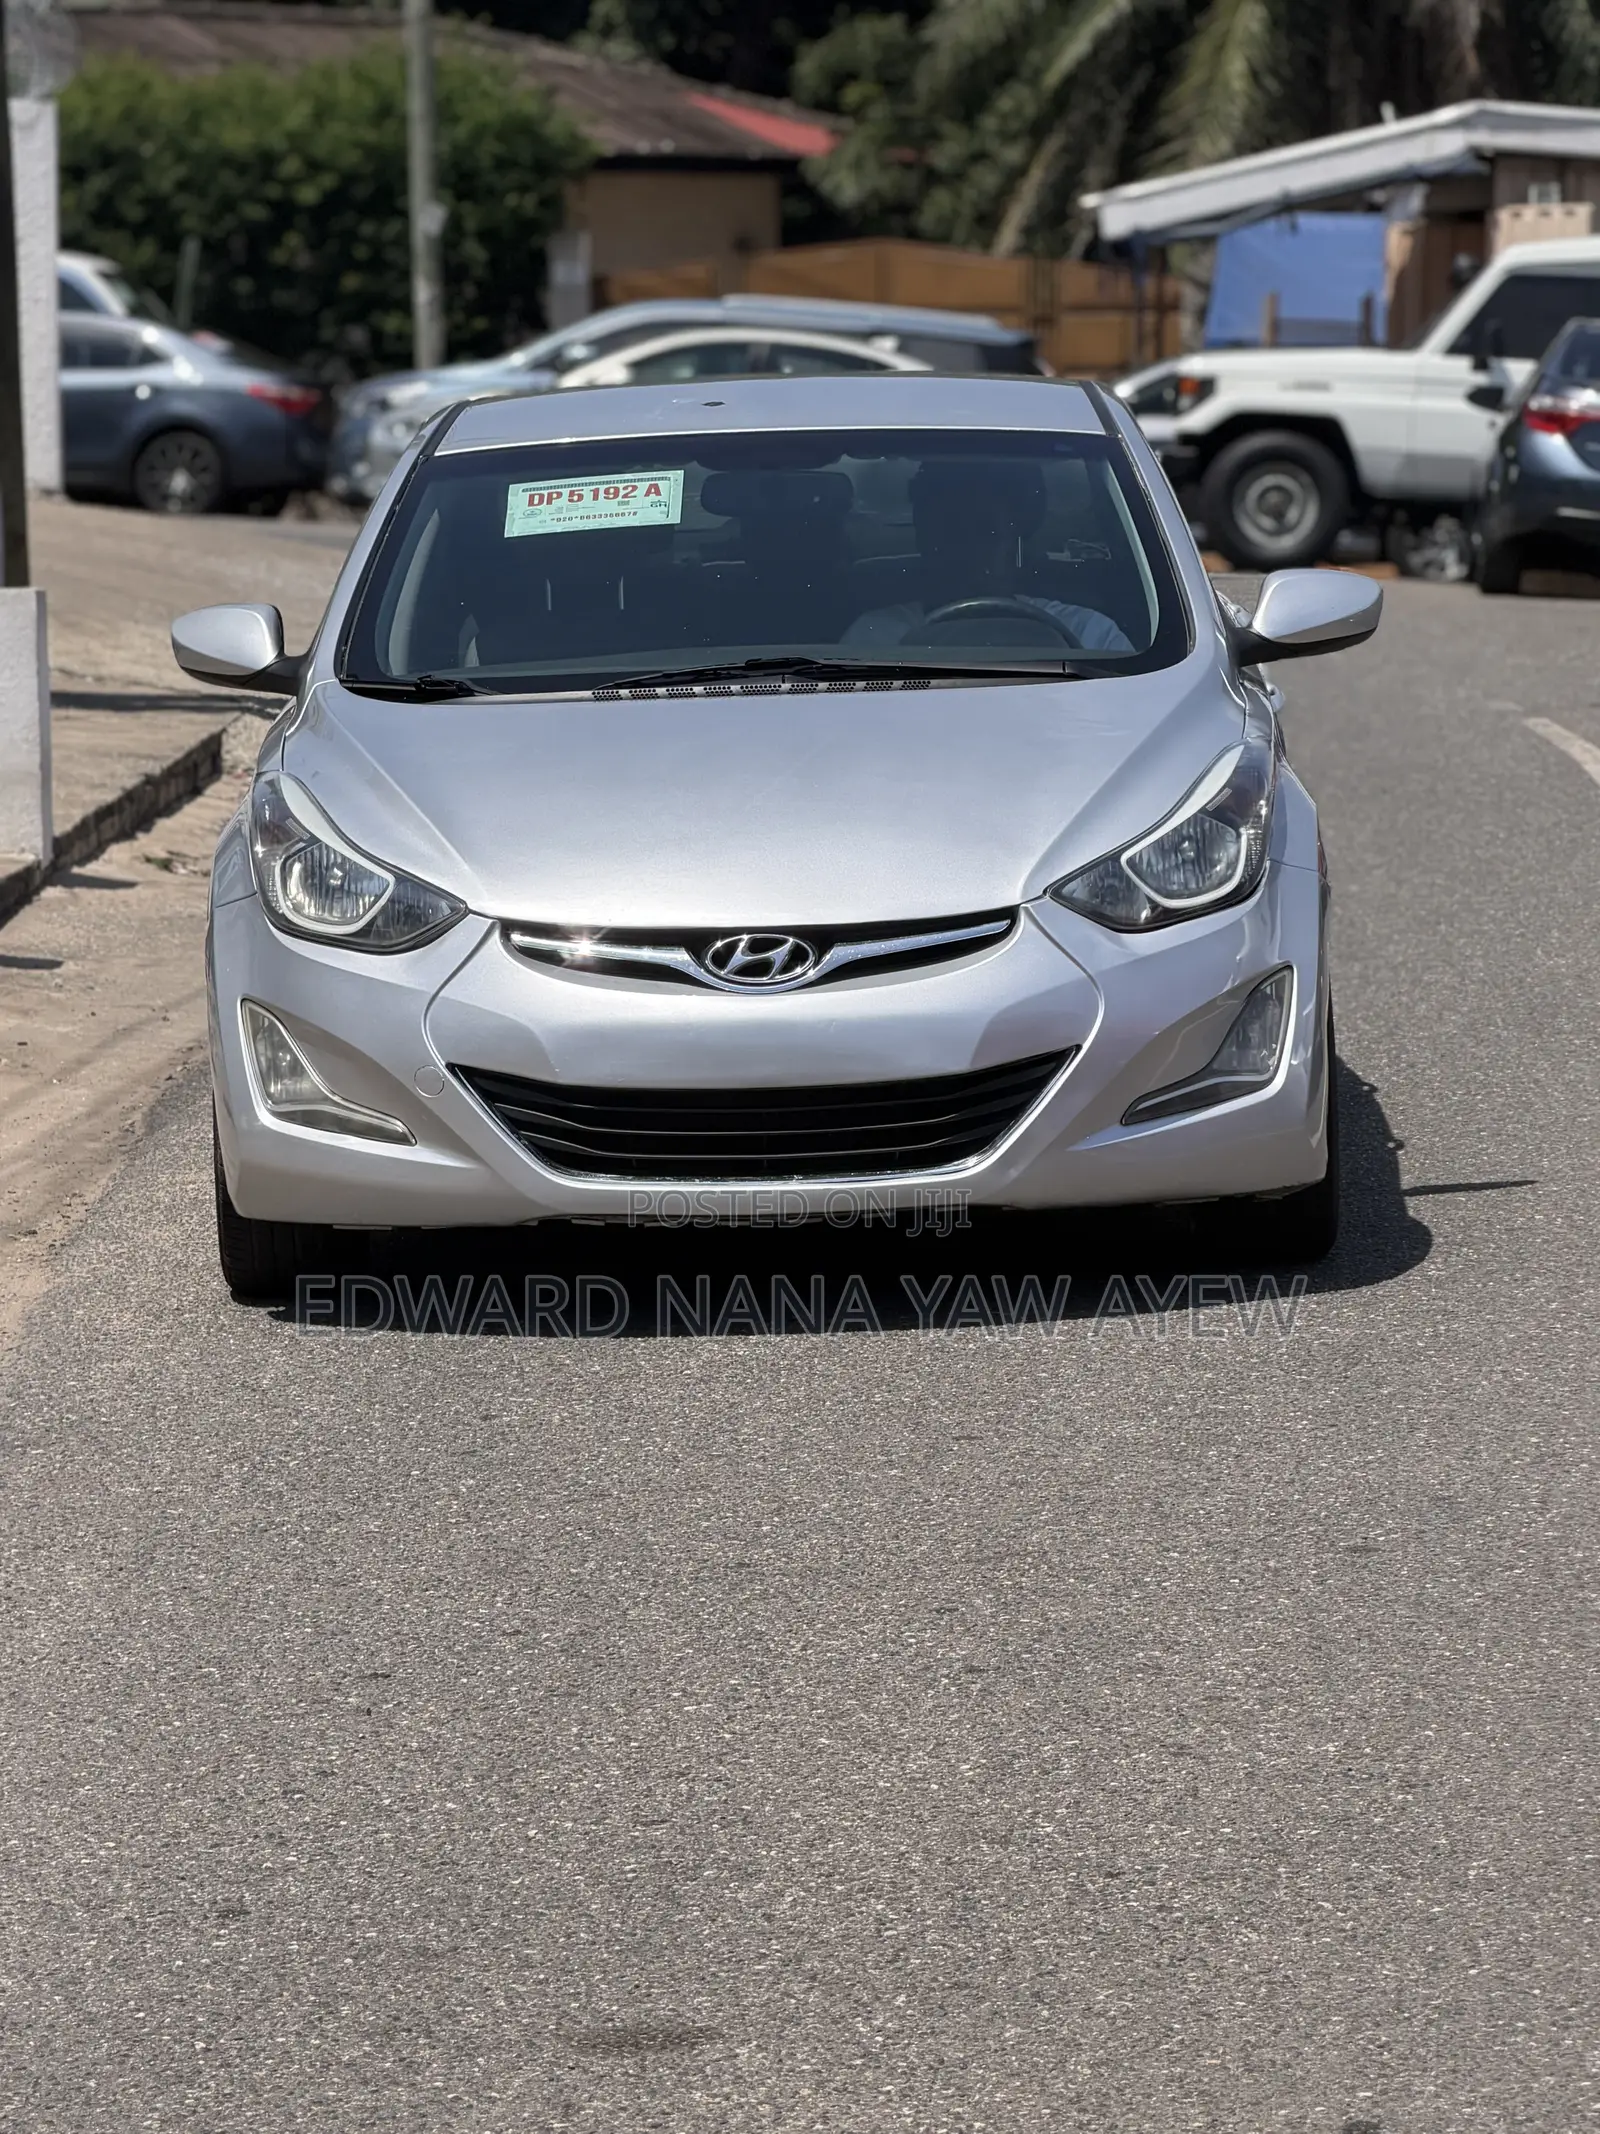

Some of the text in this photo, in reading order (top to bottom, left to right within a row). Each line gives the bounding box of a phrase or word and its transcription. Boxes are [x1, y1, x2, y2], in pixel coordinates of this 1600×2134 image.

[527, 483, 662, 507] DP 5192 A
